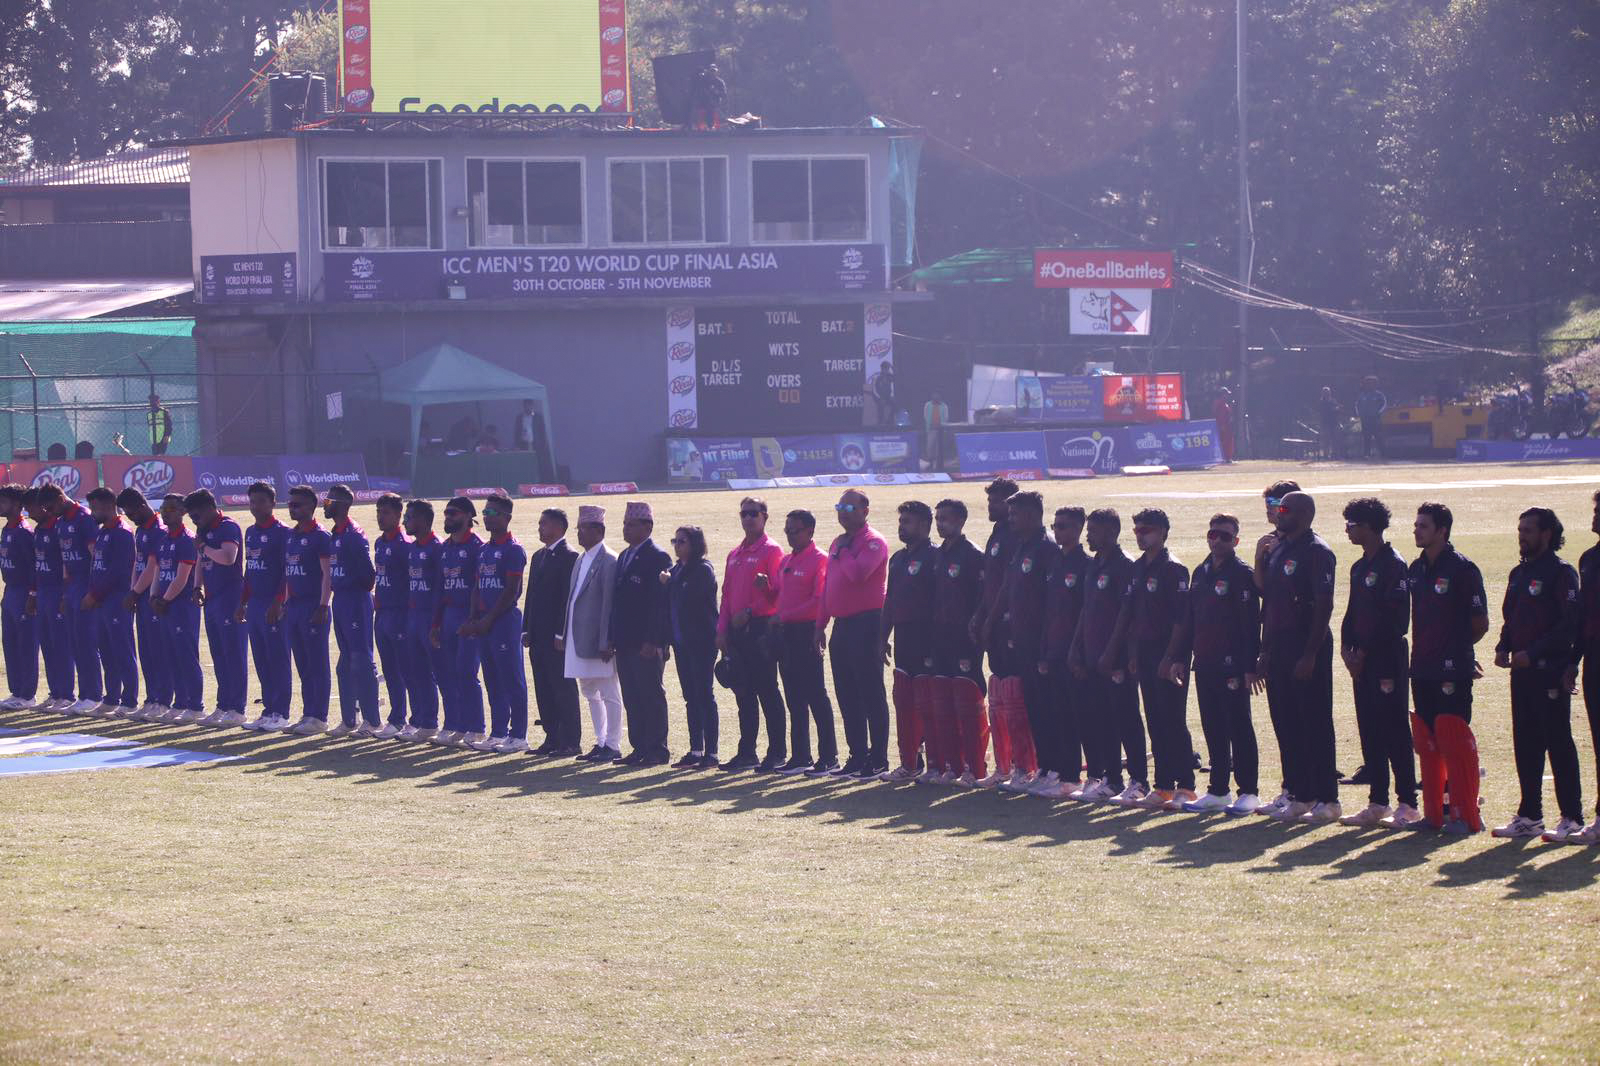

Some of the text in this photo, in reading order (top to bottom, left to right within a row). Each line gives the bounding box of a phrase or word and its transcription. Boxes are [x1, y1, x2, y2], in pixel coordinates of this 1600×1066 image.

[442, 252, 778, 274] ICC MEN'S T20 WORLD CUP FINAL ASIA
[1039, 261, 1167, 279] #OneBallBattles
[512, 279, 544, 291] 30TH
[547, 278, 606, 291] OCTOBER
[618, 277, 640, 289] 5TH
[644, 276, 712, 289] NOVEMBER
[765, 311, 801, 324] TOTAL
[1091, 323, 1109, 331] CAN
[671, 344, 693, 359] Real
[768, 342, 799, 356] WKTS
[869, 340, 889, 354] Real
[711, 359, 741, 373] D/L/S
[824, 359, 863, 372] TARGET
[672, 377, 695, 392] Real
[702, 373, 742, 386] TARGET
[767, 374, 801, 388] OVERS
[1186, 435, 1210, 448] 198
[720, 449, 751, 462] Fiber
[1060, 446, 1095, 457] National
[1101, 458, 1117, 470] Life
[131, 465, 169, 488] Real
[305, 473, 360, 483] WorldRemit
[467, 487, 497, 496] Coca-Cola
[531, 487, 560, 495] Coca-Cola
[600, 483, 628, 492] Coca-Cola
